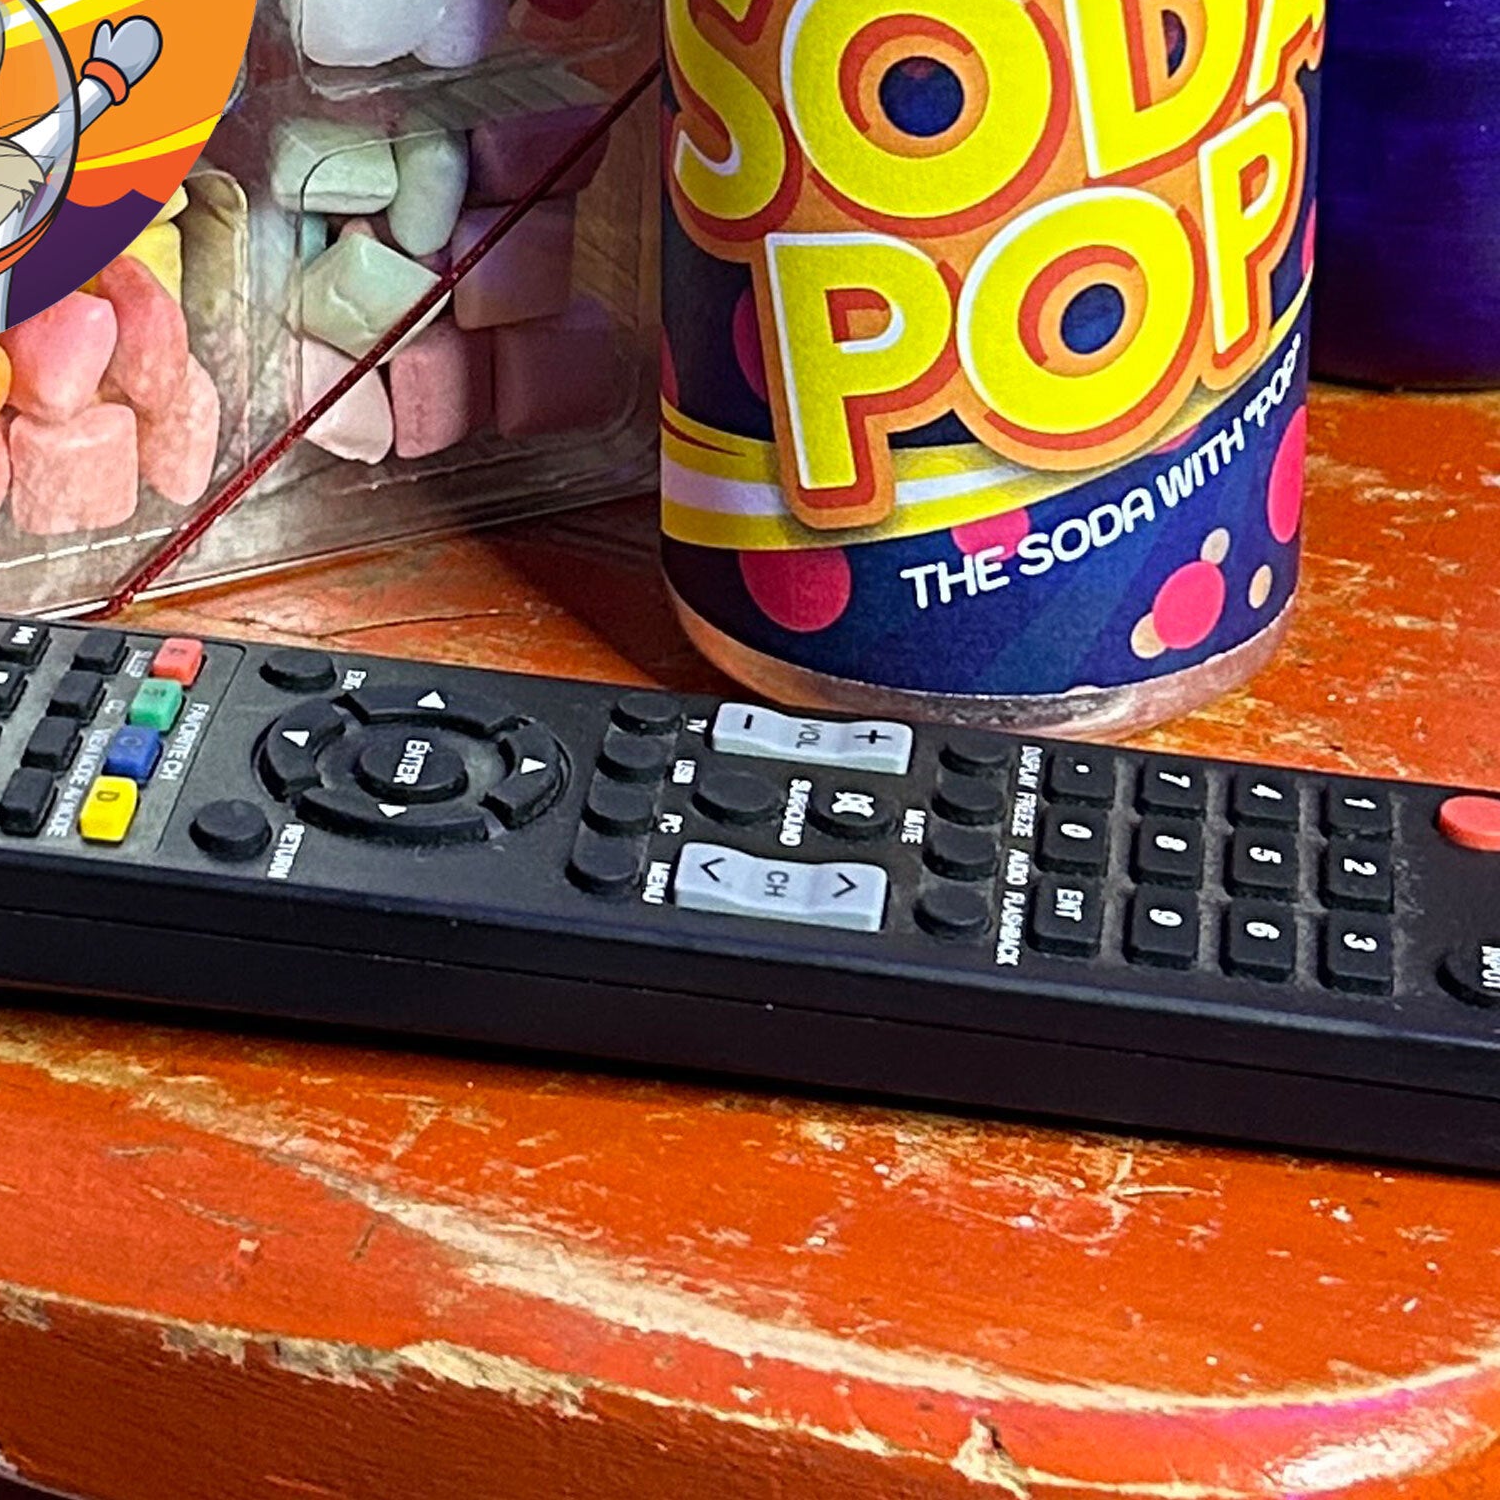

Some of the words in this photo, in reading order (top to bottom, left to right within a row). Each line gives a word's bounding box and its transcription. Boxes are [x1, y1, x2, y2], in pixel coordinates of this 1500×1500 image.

[765, 101, 1293, 491] POP
[900, 545, 1010, 609] THE
[1017, 487, 1155, 577] SODA
[1156, 416, 1246, 508] WITH
[795, 722, 824, 750] VOL
[159, 760, 183, 780] CH
[393, 739, 429, 785] ENTER
[1159, 772, 1191, 789] 7
[97, 790, 120, 802] D
[1251, 783, 1283, 800] 4
[779, 778, 813, 847] SURROUND
[1344, 798, 1377, 810] 1
[658, 813, 684, 834] PC
[901, 808, 927, 844] MUTE
[1060, 823, 1093, 839] 0
[267, 823, 305, 879] RETURN
[1155, 835, 1188, 852] 8
[1249, 846, 1282, 865] 5
[1343, 858, 1377, 876] 2
[642, 861, 672, 905] MENU
[765, 870, 790, 898] CH
[1054, 888, 1085, 922] ENT
[1149, 908, 1183, 928] 9
[1246, 921, 1280, 940] 6
[1343, 933, 1378, 952] 3
